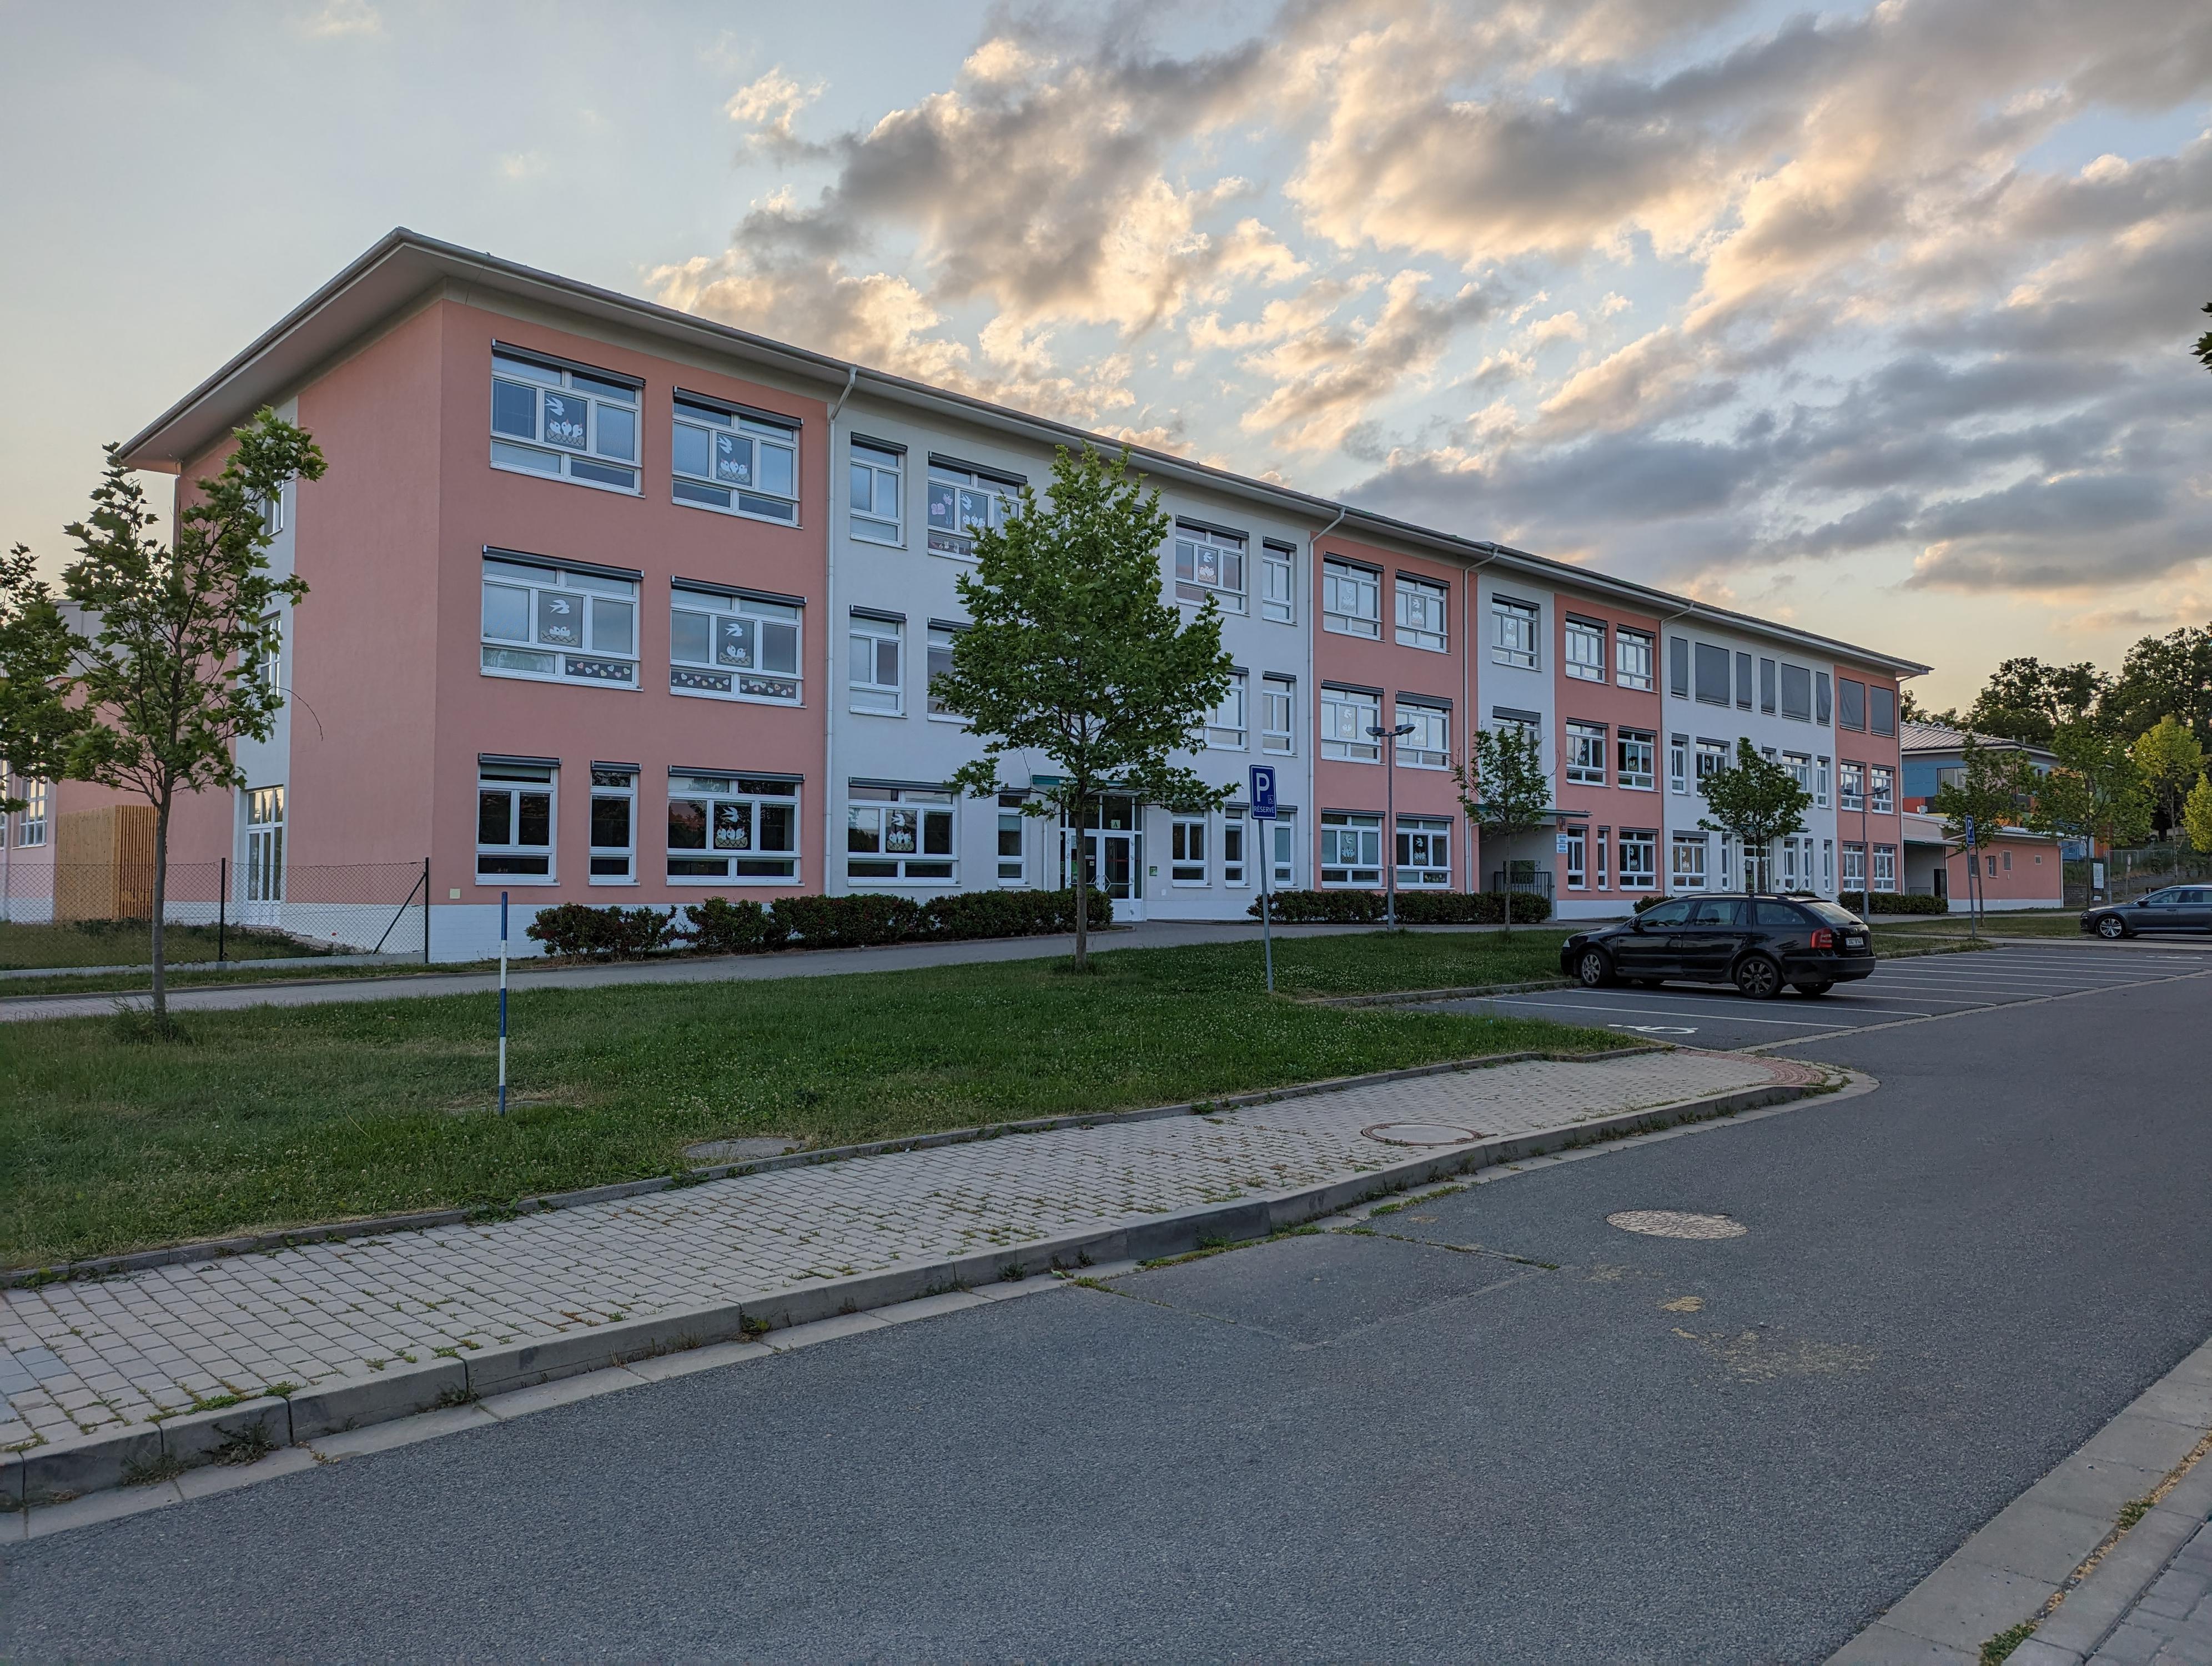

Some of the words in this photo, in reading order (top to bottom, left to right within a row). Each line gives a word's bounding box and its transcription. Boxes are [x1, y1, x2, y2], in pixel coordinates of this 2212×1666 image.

[1256, 772, 1270, 802] P
[1254, 805, 1275, 814] RÉSERVÉ
[1967, 819, 1972, 836] P
